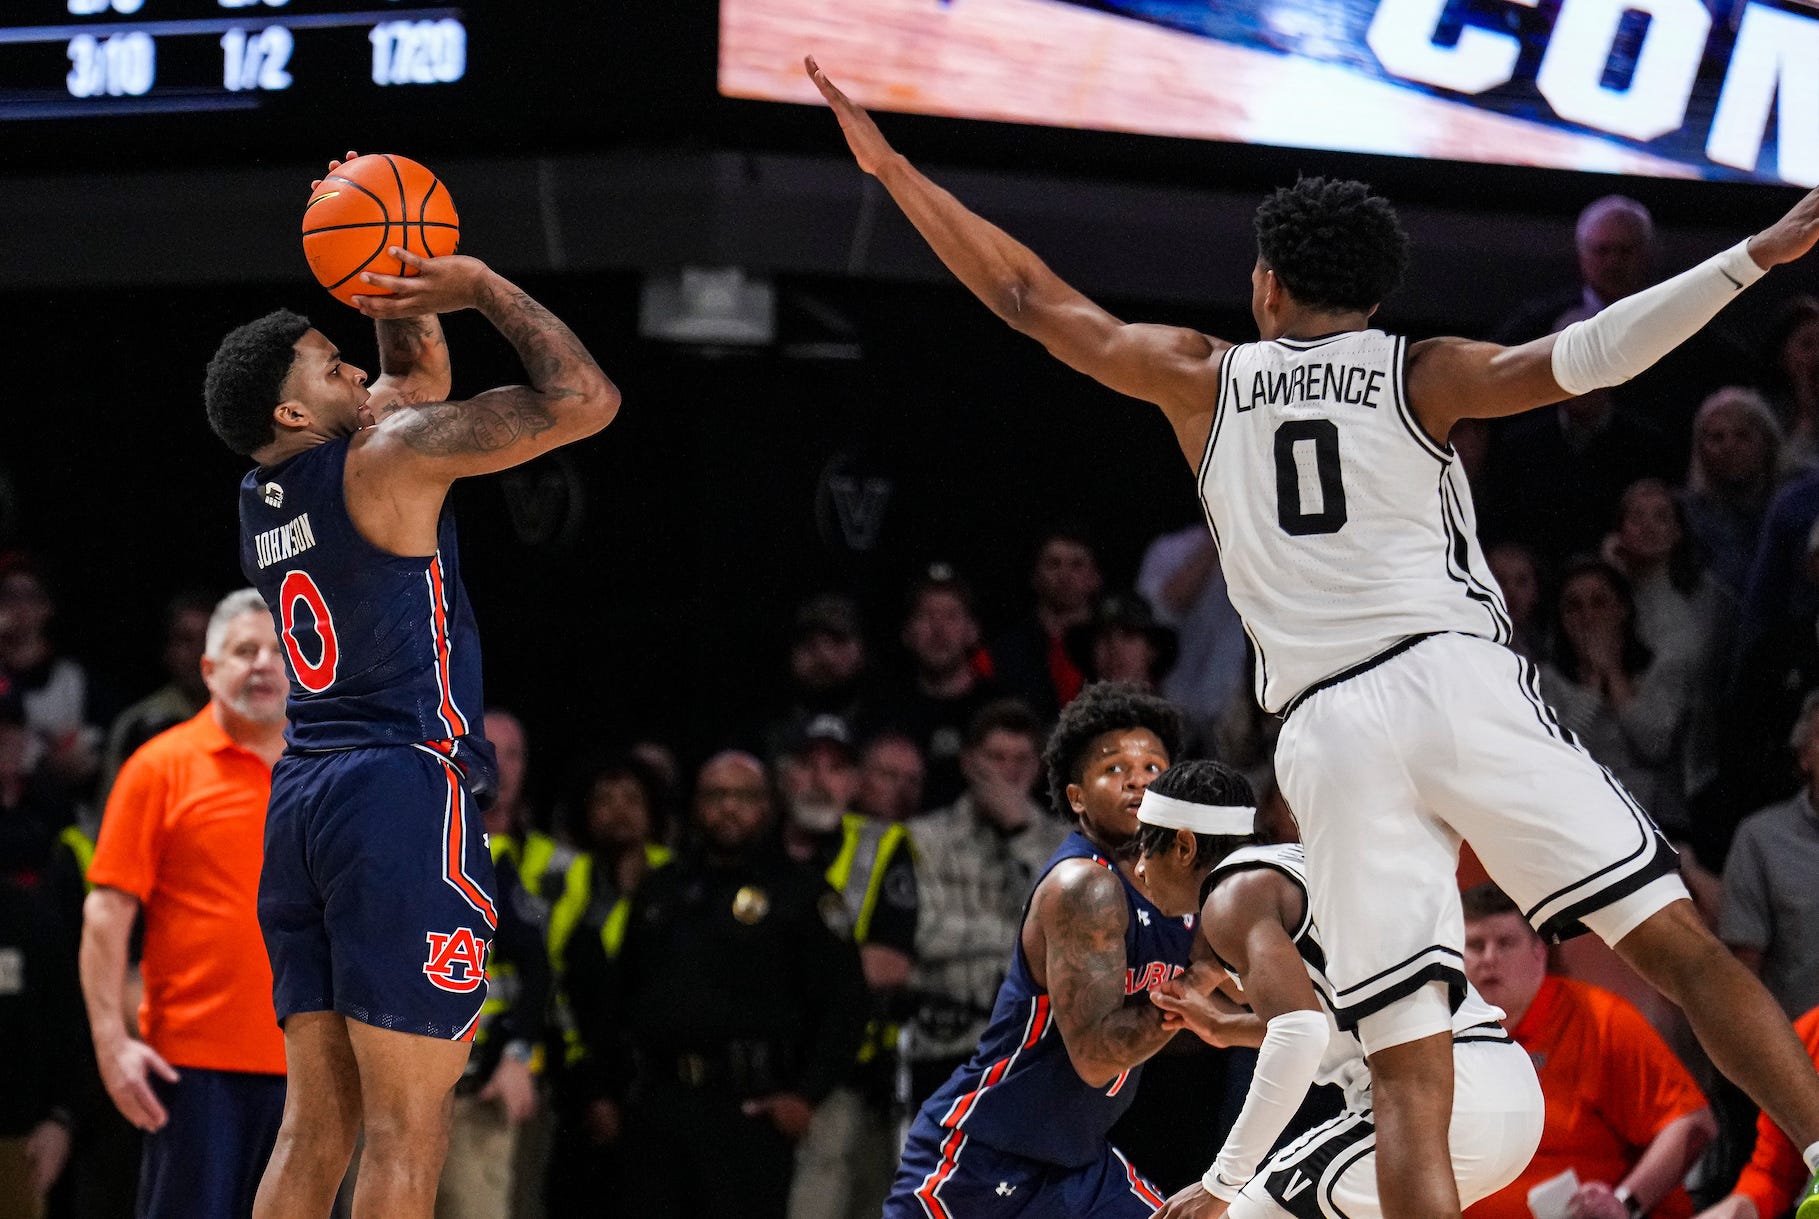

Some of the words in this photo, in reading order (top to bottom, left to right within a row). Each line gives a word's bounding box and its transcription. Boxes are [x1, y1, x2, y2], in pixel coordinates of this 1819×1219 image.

[220, 25, 293, 91] 1/2
[1232, 362, 1386, 414] LAWRENCE
[1274, 418, 1348, 537] 0
[254, 512, 316, 570] JOHNSON
[279, 569, 339, 694] 0
[1282, 1168, 1313, 1202] V
